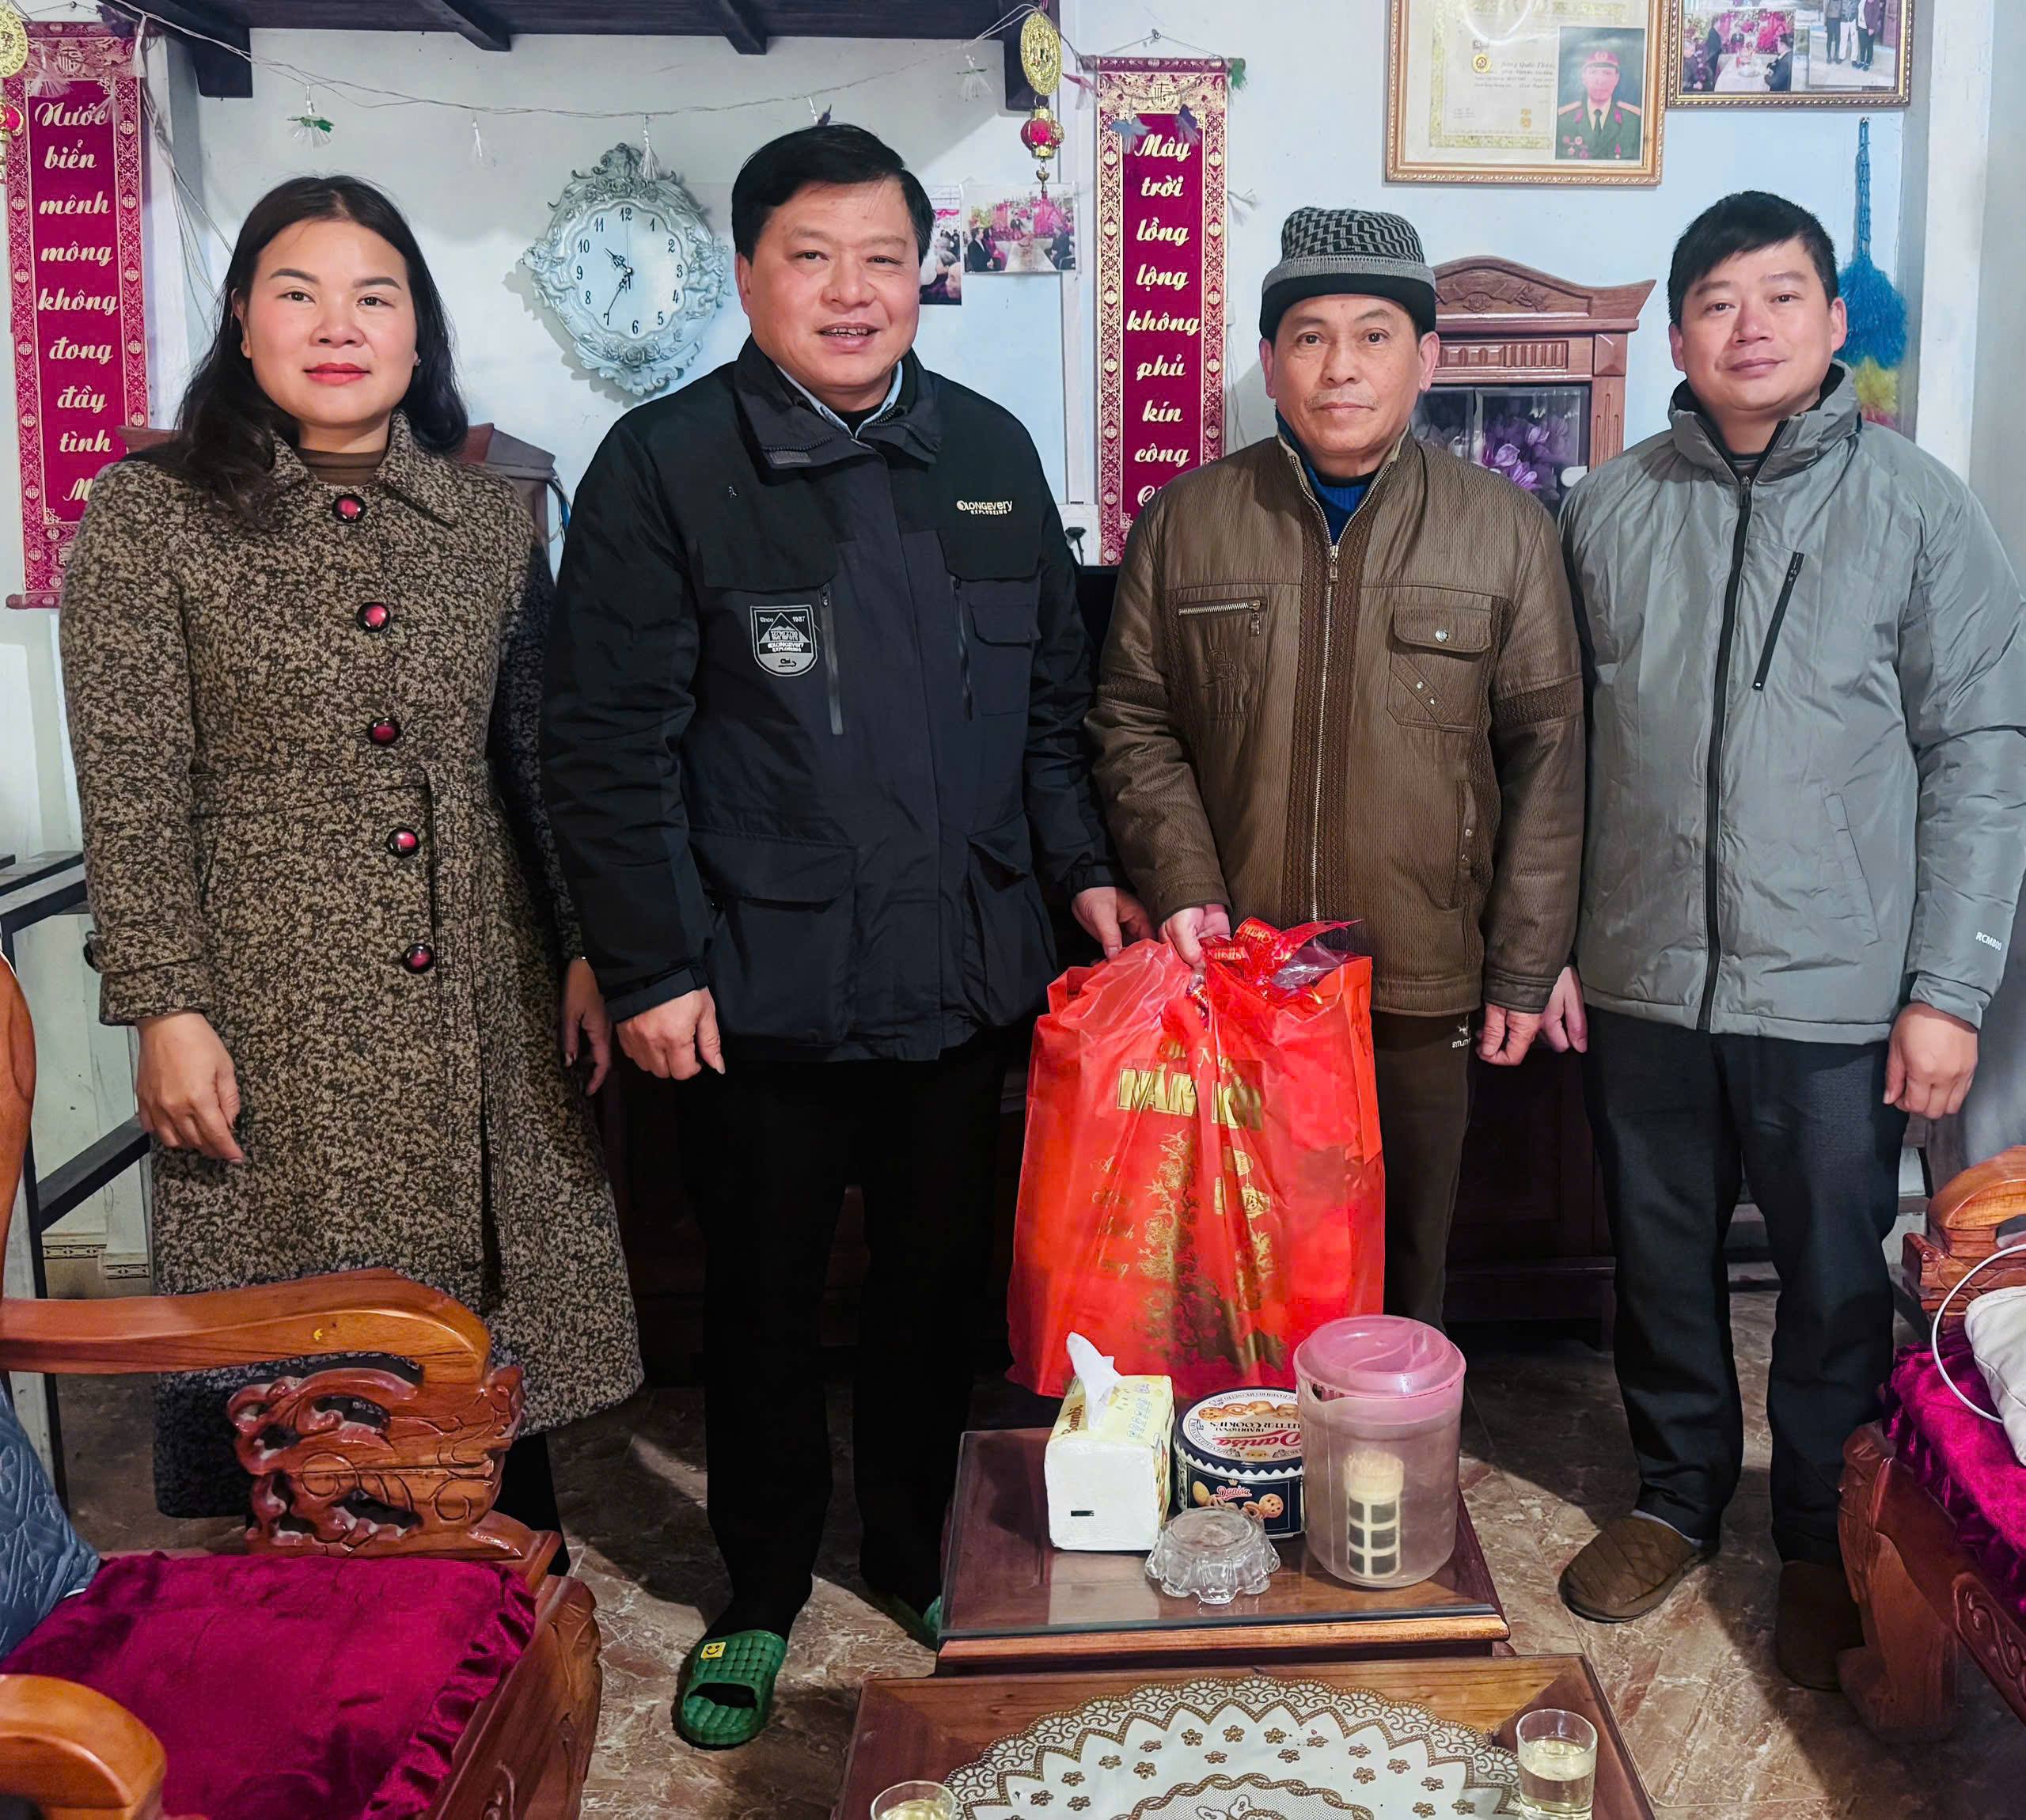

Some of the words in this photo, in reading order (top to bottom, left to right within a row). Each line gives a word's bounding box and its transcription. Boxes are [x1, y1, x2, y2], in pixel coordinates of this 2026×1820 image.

[35, 101, 108, 127] Nước
[44, 139, 97, 169] biển
[1134, 134, 1191, 162] Mây
[1140, 175, 1185, 197] trời
[39, 191, 111, 216] mênh
[620, 207, 632, 222] 12
[594, 218, 604, 232] 11
[650, 218, 655, 232] 1
[1136, 217, 1190, 246] lồng
[40, 241, 114, 267] mông
[578, 239, 590, 253] 10
[668, 239, 675, 253] 2
[576, 266, 583, 280] 9
[677, 265, 683, 279] 3
[1135, 264, 1189, 292] lộng
[37, 287, 118, 316] không
[585, 290, 591, 305] 8
[673, 290, 679, 304] 4
[603, 313, 610, 326] 7
[632, 320, 639, 334] 6
[658, 311, 664, 325] 5
[1126, 309, 1201, 336] không
[49, 336, 113, 365] đong
[1136, 354, 1186, 381] phủ
[57, 385, 108, 413] đầy
[1142, 400, 1183, 423] kín
[59, 429, 112, 453] tình
[1134, 442, 1190, 467] công
[1212, 1430, 1301, 1450] Danisa
[1216, 1484, 1253, 1501] Danisa
